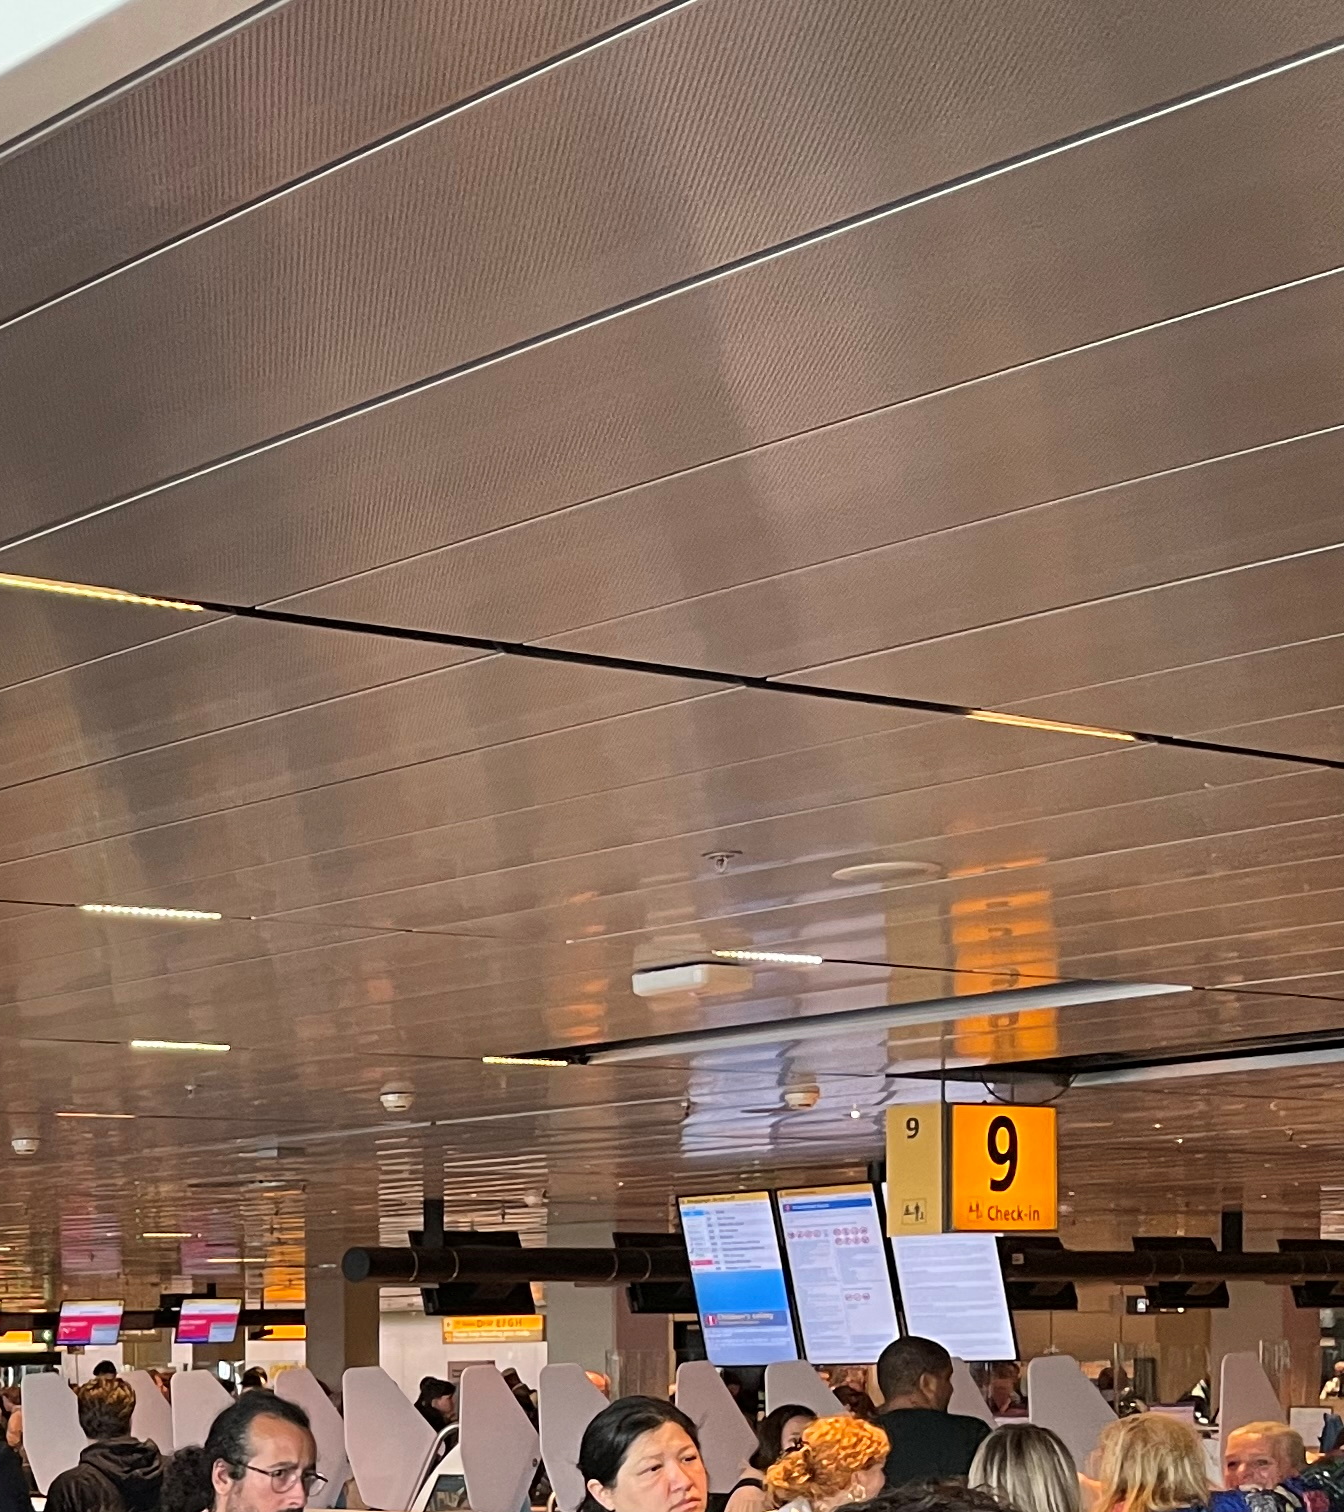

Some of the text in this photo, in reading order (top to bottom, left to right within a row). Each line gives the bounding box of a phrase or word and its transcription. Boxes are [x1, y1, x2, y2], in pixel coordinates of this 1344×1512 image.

[906, 1117, 919, 1139] 9
[987, 1115, 1018, 1192] 9
[987, 1205, 1040, 1221] Check-in
